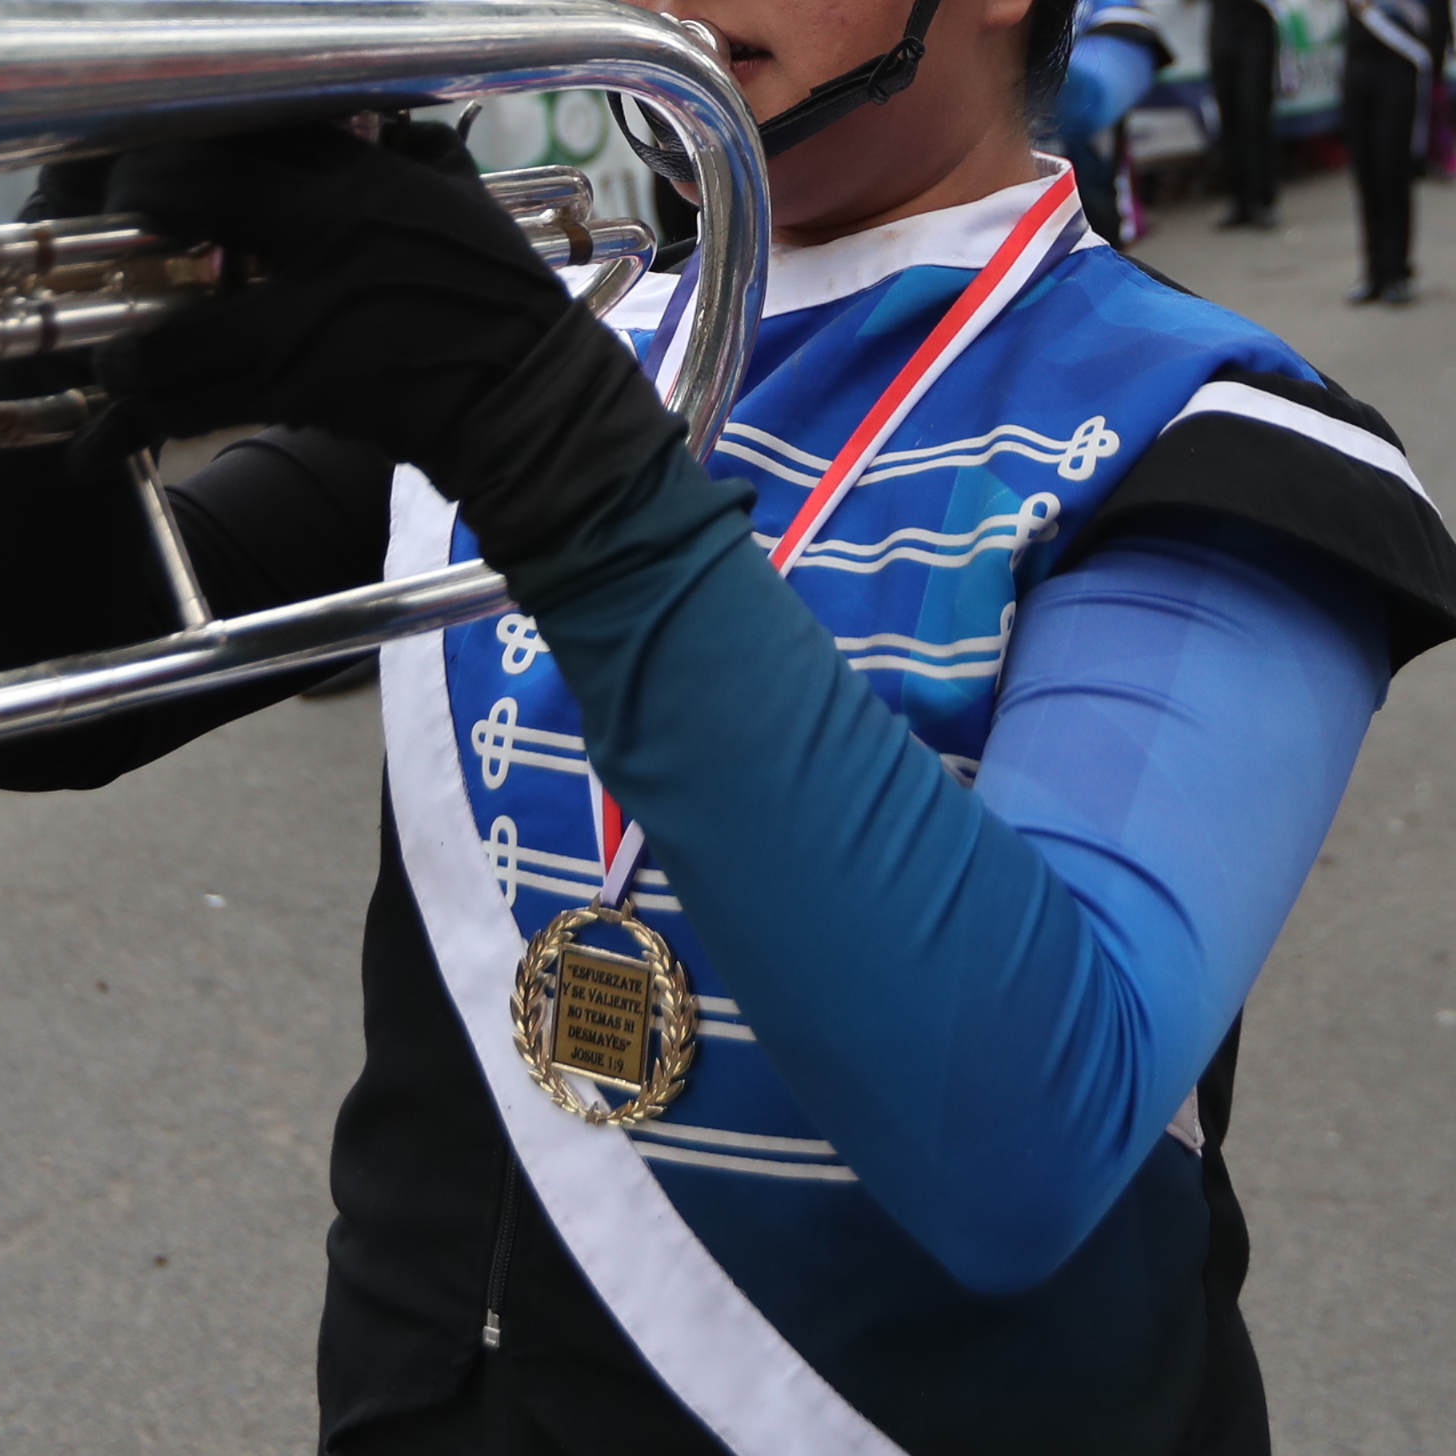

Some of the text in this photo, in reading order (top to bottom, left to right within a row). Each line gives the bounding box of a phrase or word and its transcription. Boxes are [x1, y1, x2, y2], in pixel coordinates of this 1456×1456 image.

[563, 982, 644, 1017] Y SE VALIENTE,
[568, 1005, 635, 1033] NO TEMAS NI
[571, 1047, 624, 1073] JOSUE 1:9
